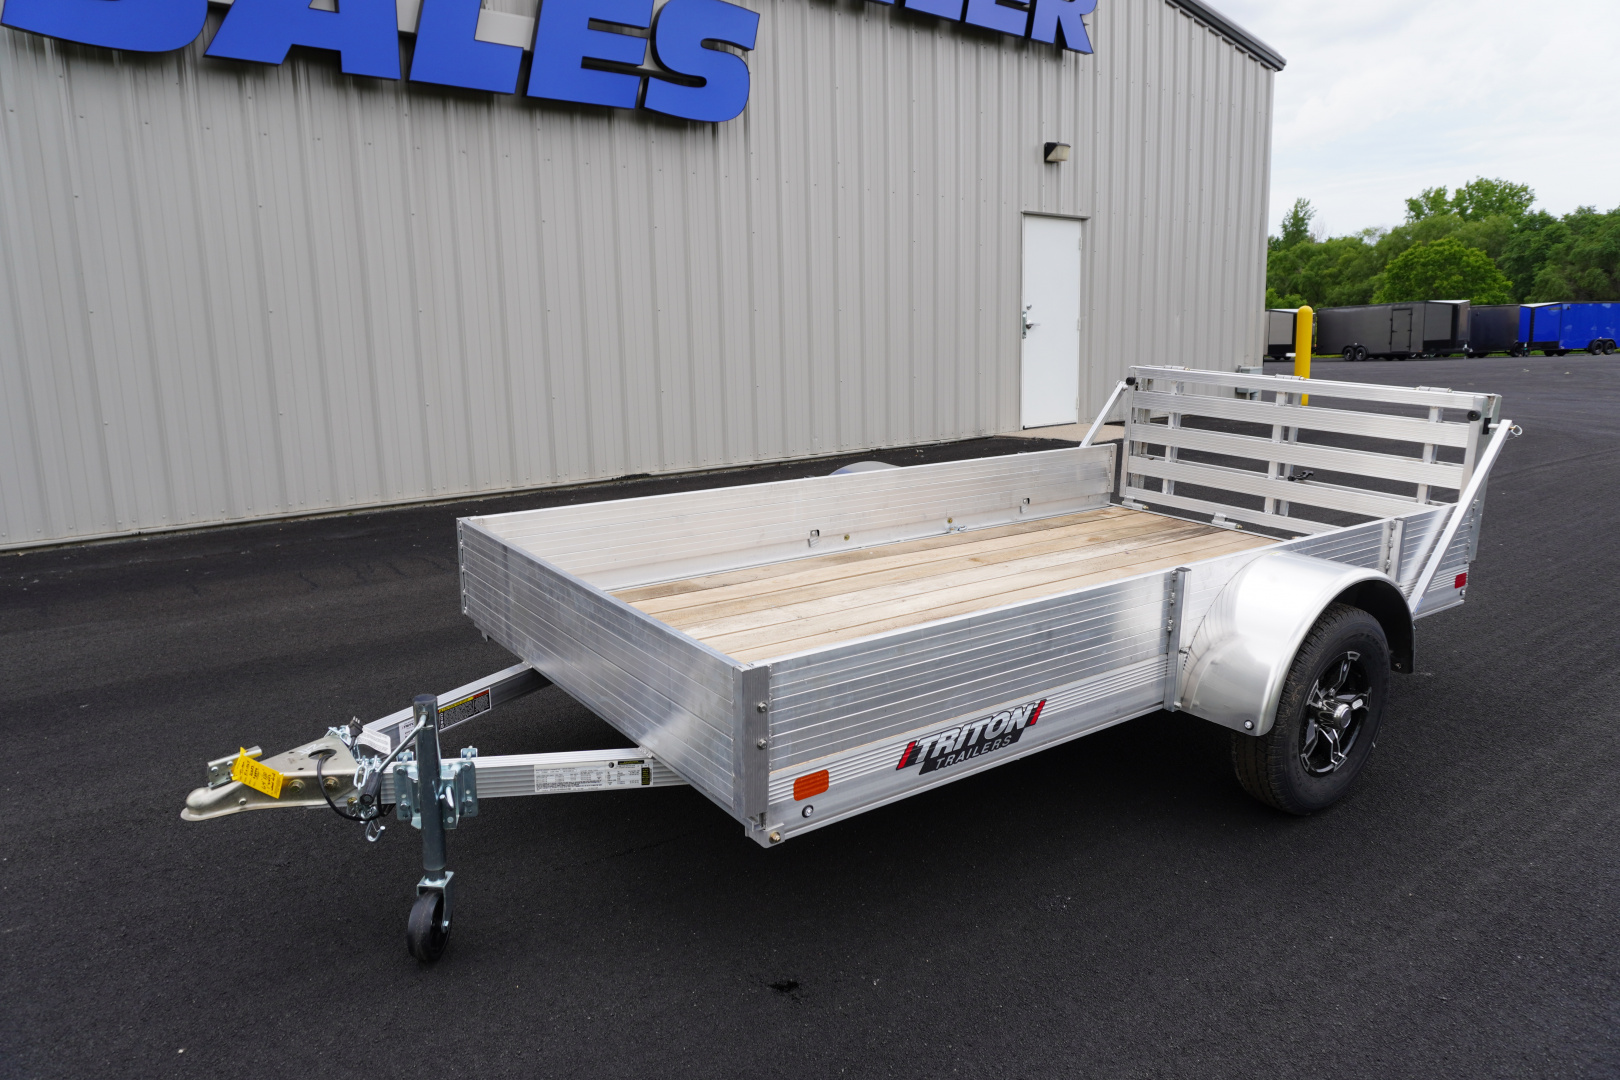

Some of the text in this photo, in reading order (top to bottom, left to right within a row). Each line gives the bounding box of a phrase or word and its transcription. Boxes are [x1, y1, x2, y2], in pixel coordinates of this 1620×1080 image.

[0, 0, 760, 123] ALES
[915, 702, 1036, 764] TRITON
[936, 734, 1012, 771] TRAILERS
